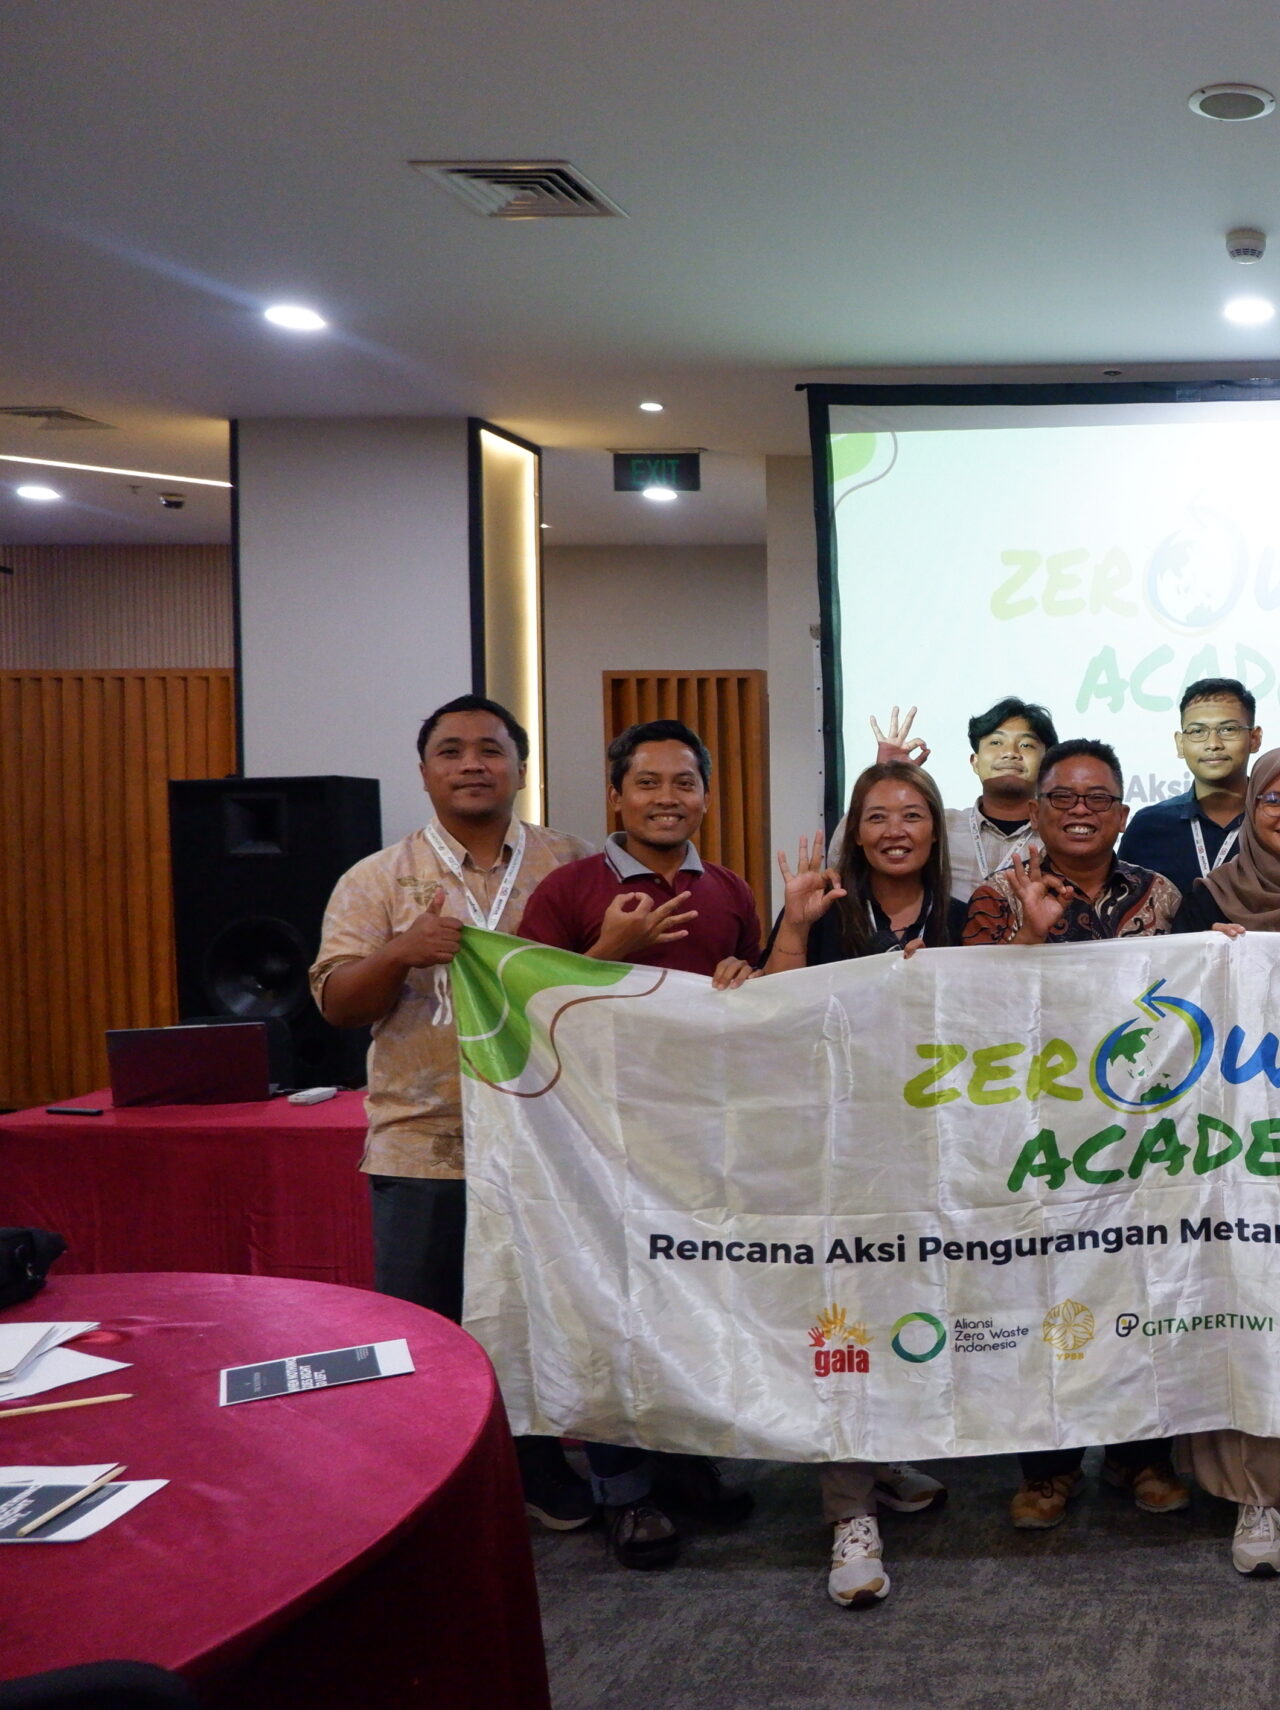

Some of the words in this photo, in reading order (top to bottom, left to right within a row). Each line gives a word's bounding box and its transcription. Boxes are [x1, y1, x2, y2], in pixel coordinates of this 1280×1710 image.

[630, 458, 679, 487] EXIT
[1124, 771, 1191, 803] Aksi
[649, 1233, 814, 1265] Rencana
[826, 1234, 906, 1264] Aksi
[918, 1224, 1168, 1266] Pengurangan
[954, 1317, 993, 1329] Aliansi
[954, 1330, 985, 1342] Zero
[989, 1325, 1029, 1339] Waste
[814, 1344, 870, 1377] gaia
[954, 1339, 1017, 1353] Indonesia
